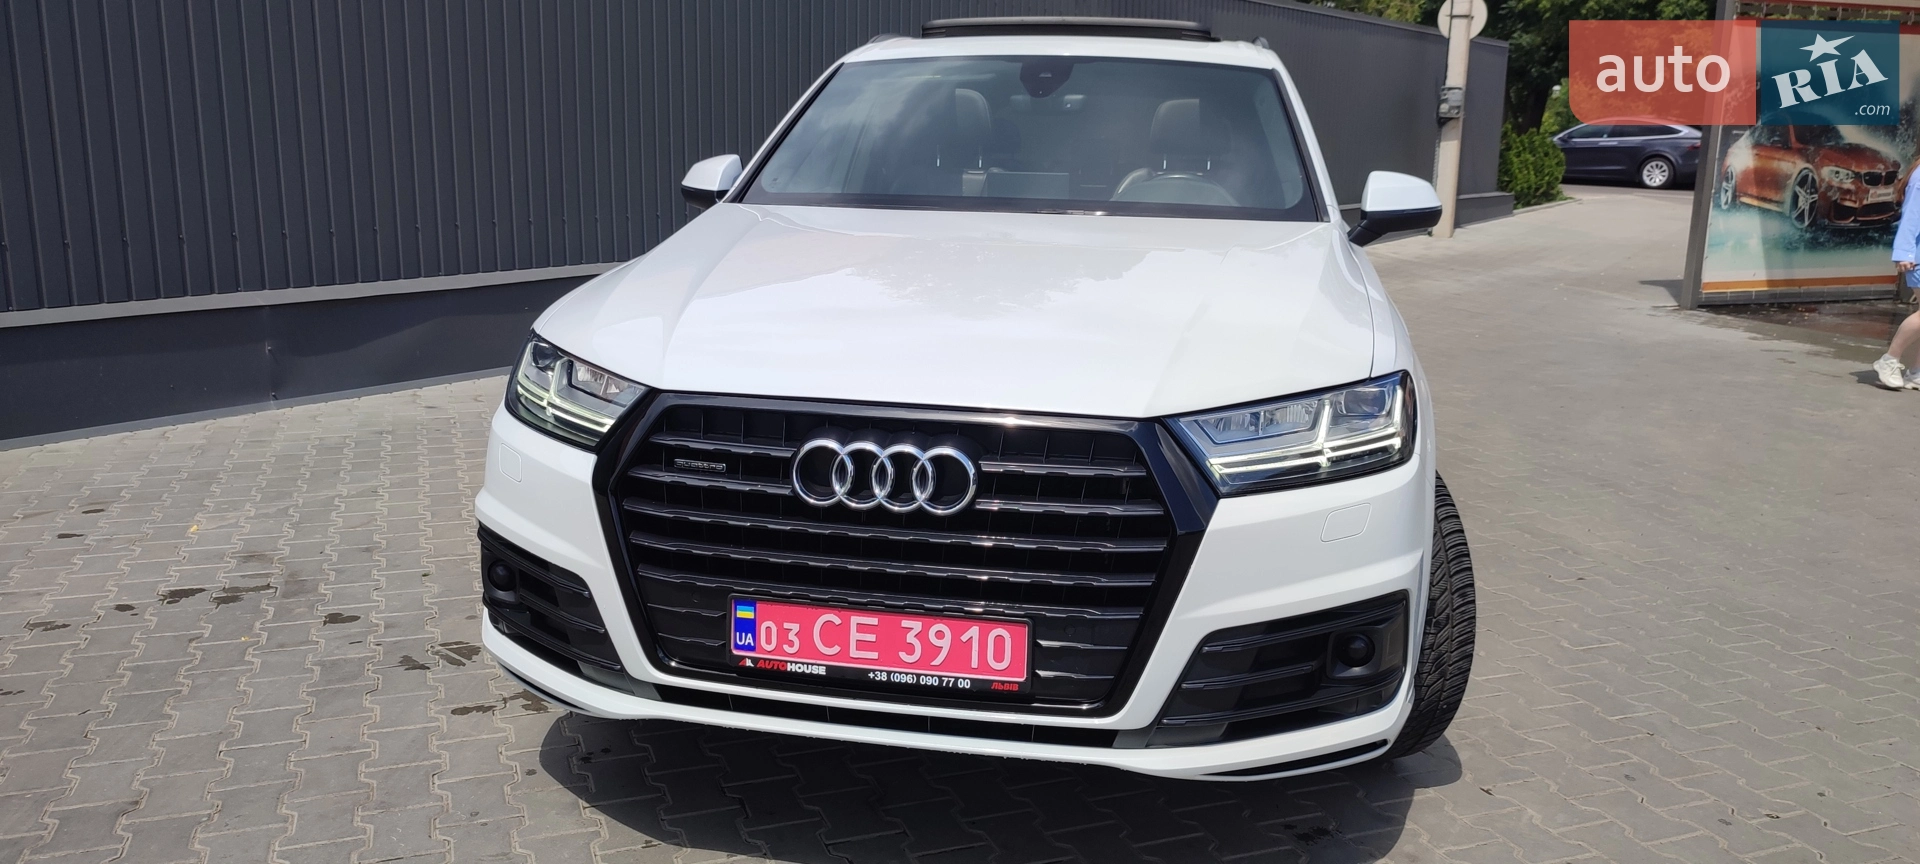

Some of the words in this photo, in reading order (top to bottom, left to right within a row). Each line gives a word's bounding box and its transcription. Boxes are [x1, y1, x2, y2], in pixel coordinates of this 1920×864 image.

[736, 631, 754, 647] UA
[760, 620, 800, 654] 03
[813, 613, 879, 660] CE
[898, 620, 1012, 670] 3910
[757, 659, 827, 675] AUTOHOUSE
[868, 671, 888, 682] +38
[890, 672, 917, 684] (096)
[919, 675, 939, 686] 090
[941, 676, 955, 687] 77
[957, 678, 971, 689] 00
